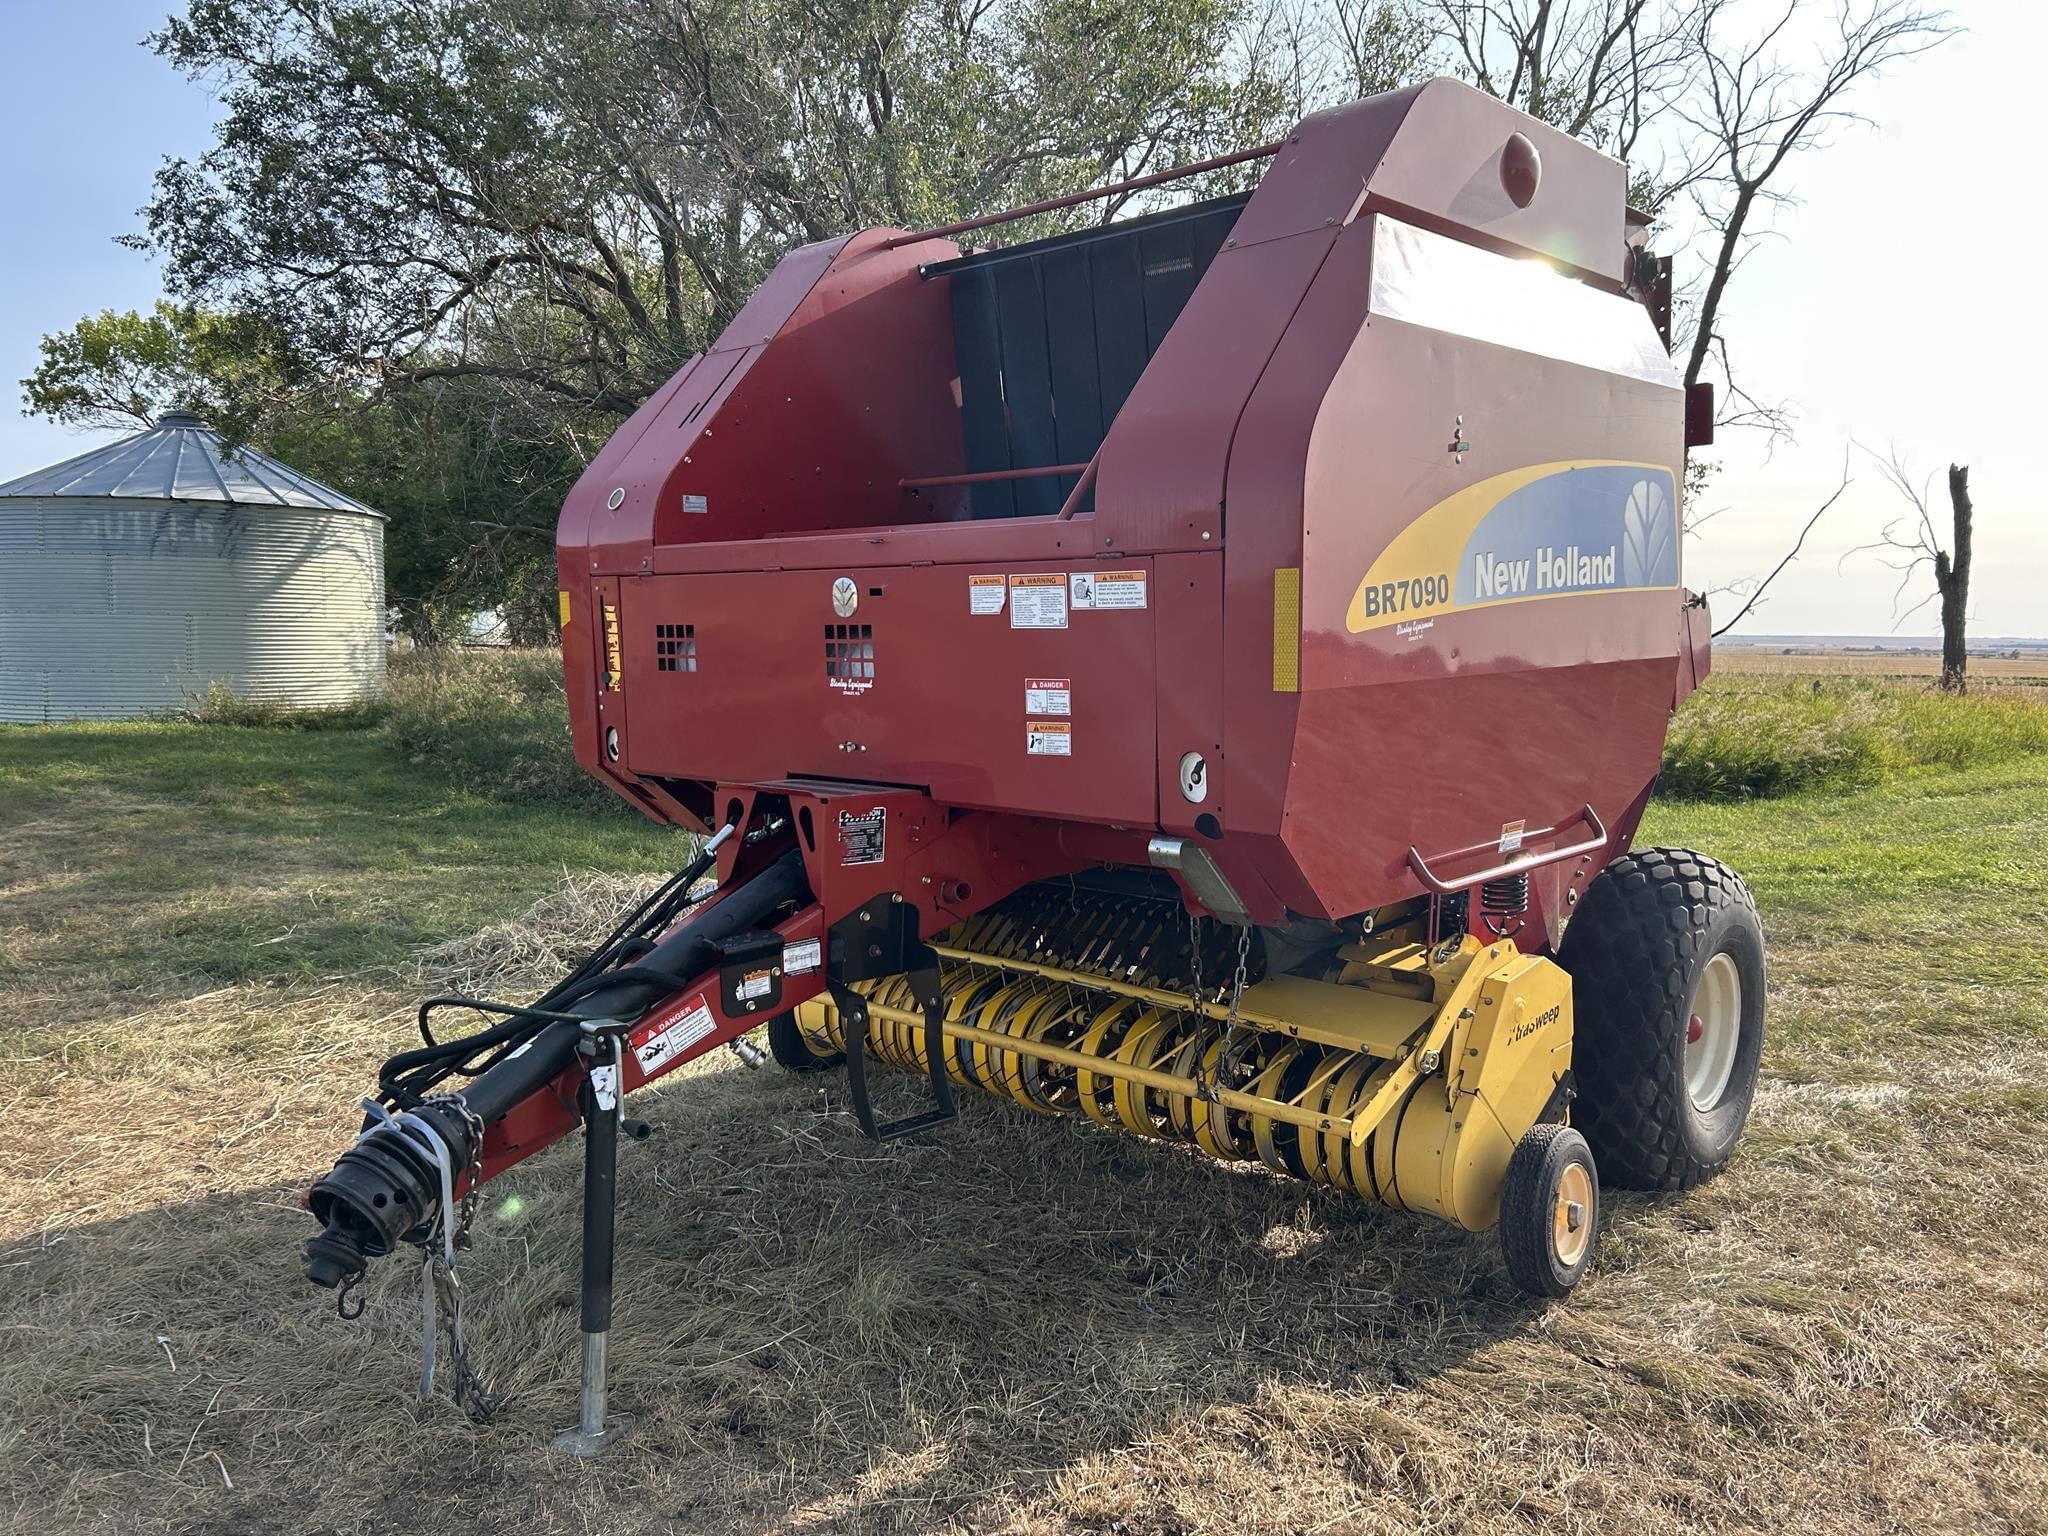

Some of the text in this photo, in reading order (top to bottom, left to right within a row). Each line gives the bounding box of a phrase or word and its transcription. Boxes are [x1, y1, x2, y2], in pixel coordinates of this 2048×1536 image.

[1474, 545, 1616, 598] New Holland
[1365, 574, 1449, 618] BR7090
[1040, 681, 1064, 689] DANGER
[659, 1006, 692, 1031] DANGER
